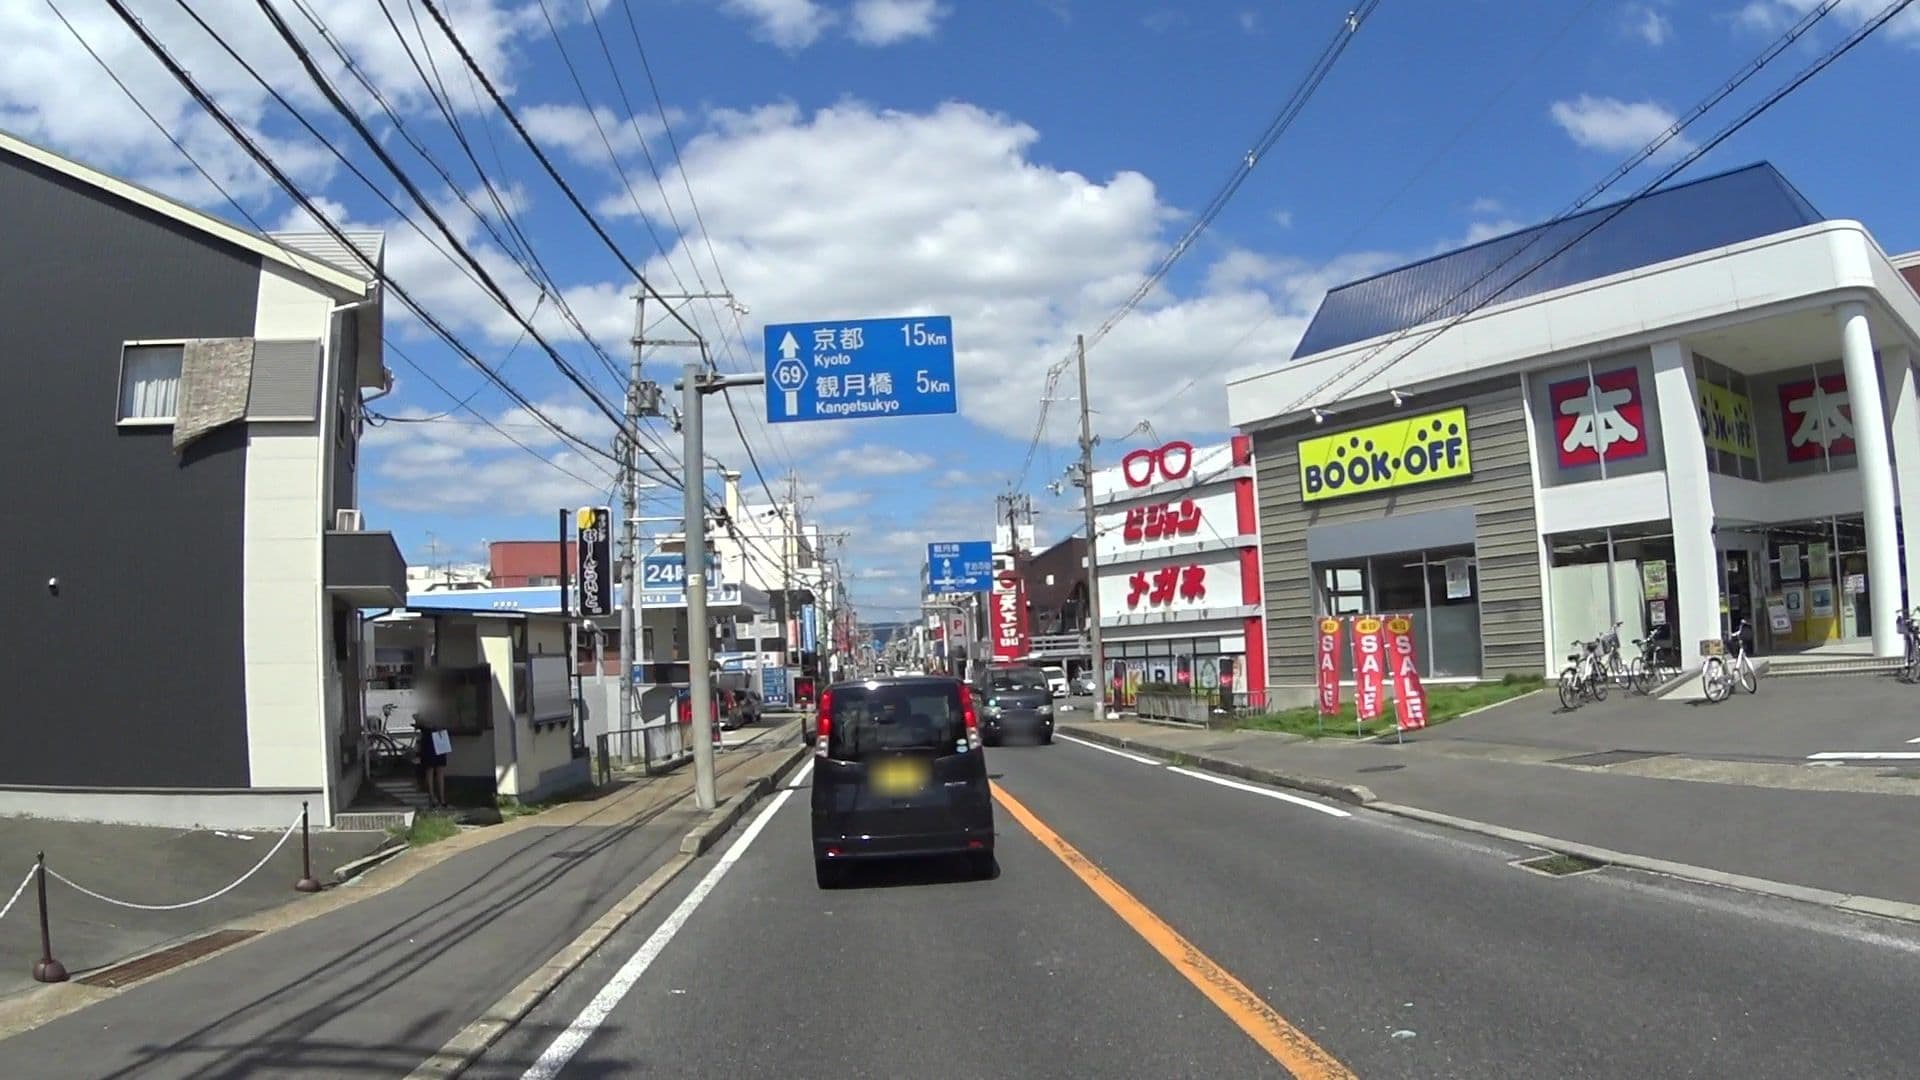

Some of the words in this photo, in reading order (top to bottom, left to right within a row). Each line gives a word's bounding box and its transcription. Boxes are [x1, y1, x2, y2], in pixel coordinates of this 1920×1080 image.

[813, 328, 864, 350] 京都
[814, 353, 851, 368] Kyoto
[779, 366, 801, 384] 69
[816, 372, 892, 398] 観月橋
[816, 399, 900, 416] Kangetsukyo
[1560, 385, 1639, 454] 本
[1788, 386, 1854, 448] 本
[1124, 497, 1201, 543] ビジョン
[1127, 563, 1206, 608] メガネ
[1321, 635, 1335, 707] SALE
[1361, 635, 1379, 710] SALE
[1396, 636, 1423, 719] SALE
